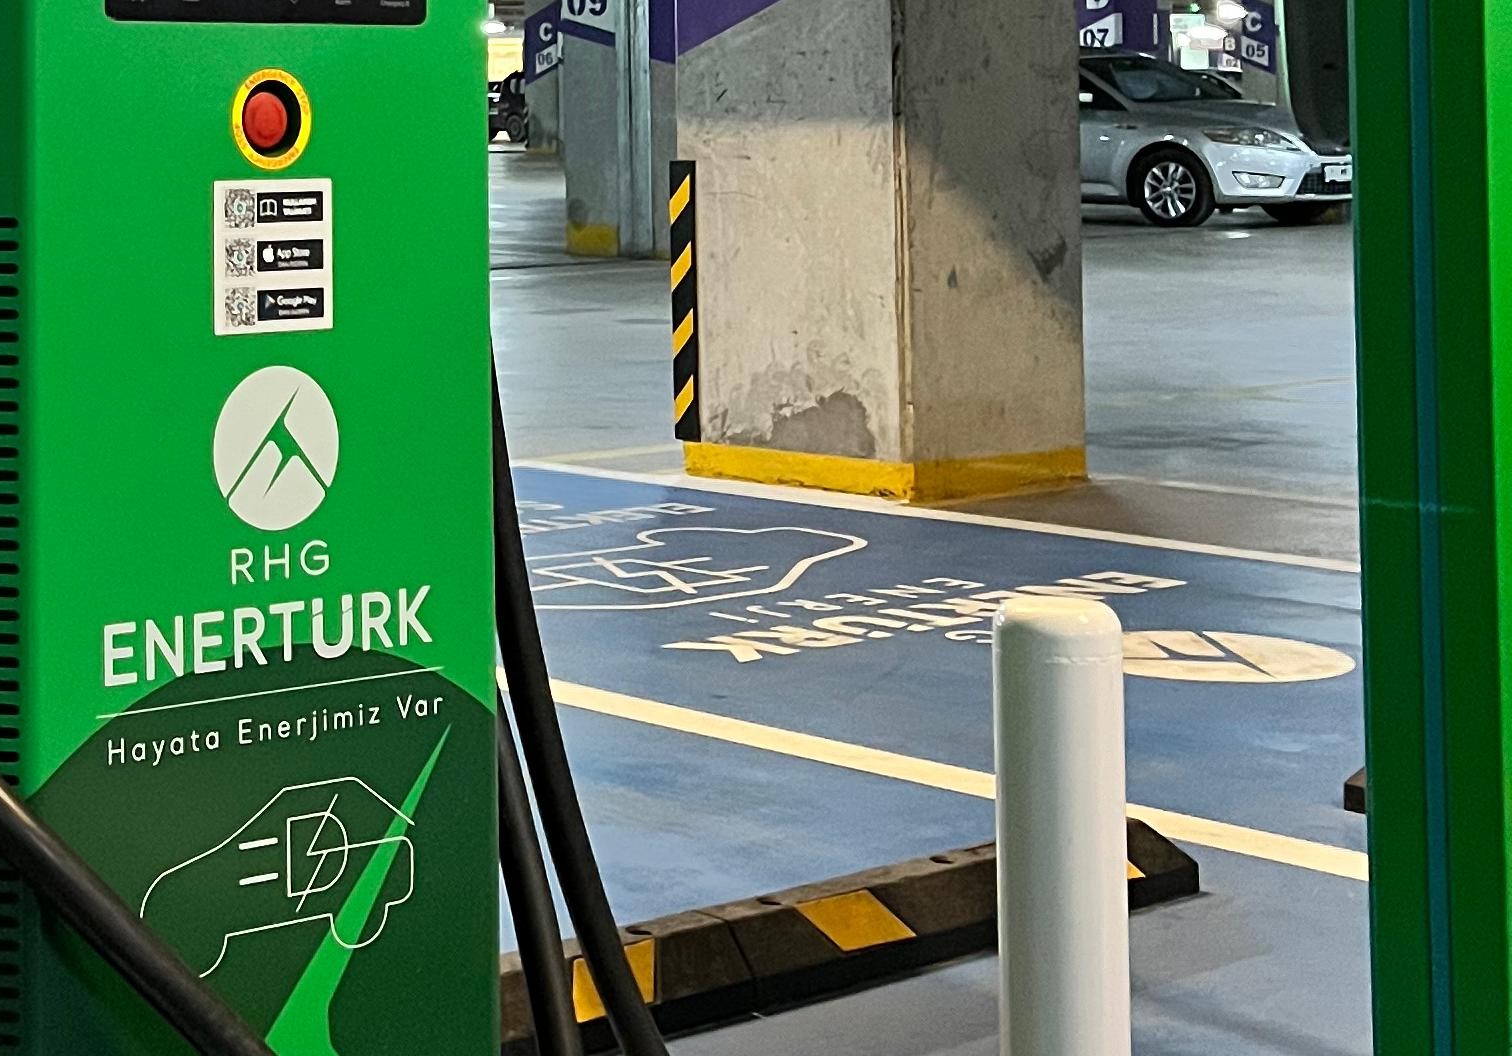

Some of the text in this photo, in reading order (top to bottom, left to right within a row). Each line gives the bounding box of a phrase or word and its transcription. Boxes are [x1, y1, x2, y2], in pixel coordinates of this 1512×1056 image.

[539, 22, 553, 41] C
[1245, 11, 1262, 32] C
[1246, 44, 1266, 58] 05
[231, 540, 330, 584] RHG
[107, 695, 445, 766] Hayata Enerjimiz Var
